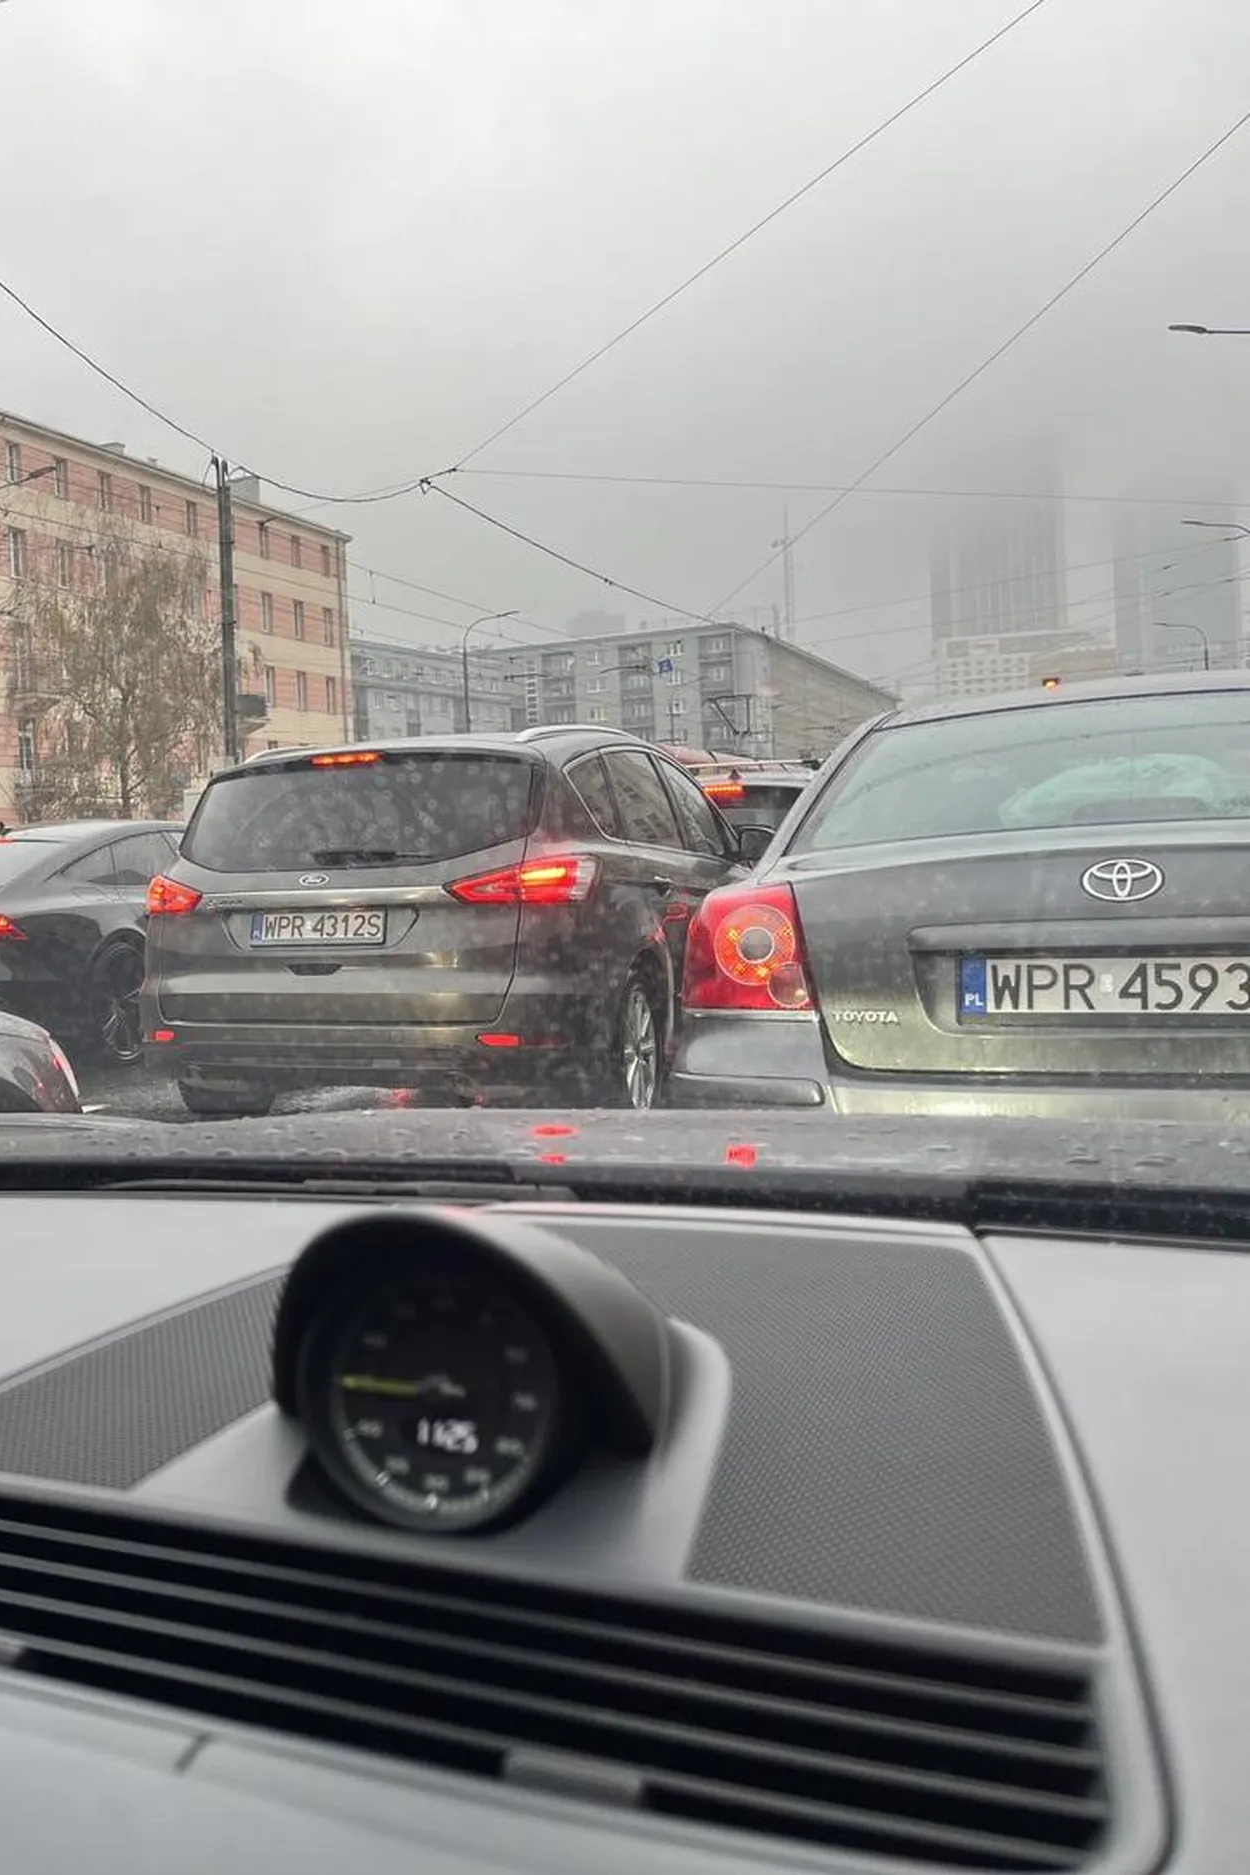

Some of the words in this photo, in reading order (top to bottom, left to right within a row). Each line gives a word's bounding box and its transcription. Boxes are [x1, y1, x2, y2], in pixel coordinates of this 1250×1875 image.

[264, 915, 305, 938] WPR
[312, 913, 382, 938] 4312S
[991, 963, 1096, 1011] WPR
[1118, 962, 1250, 1011] 4593
[964, 992, 984, 1007] PL
[832, 1010, 899, 1023] TOYOTA
